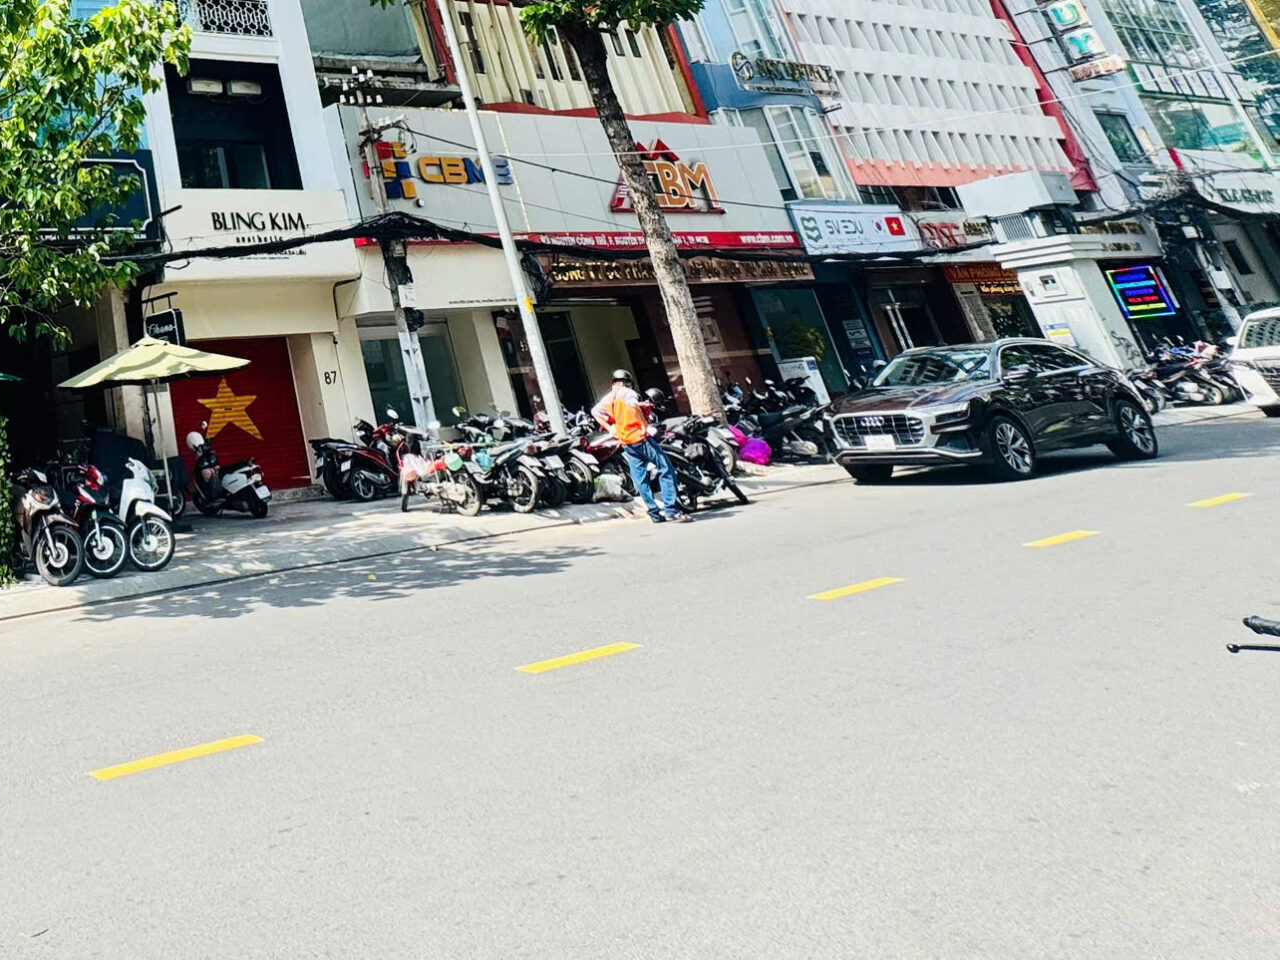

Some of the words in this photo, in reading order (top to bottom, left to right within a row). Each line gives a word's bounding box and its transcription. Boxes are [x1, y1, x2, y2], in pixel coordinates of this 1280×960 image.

[211, 212, 266, 231] BLING
[269, 212, 306, 231] KIM
[324, 371, 336, 385] 87
